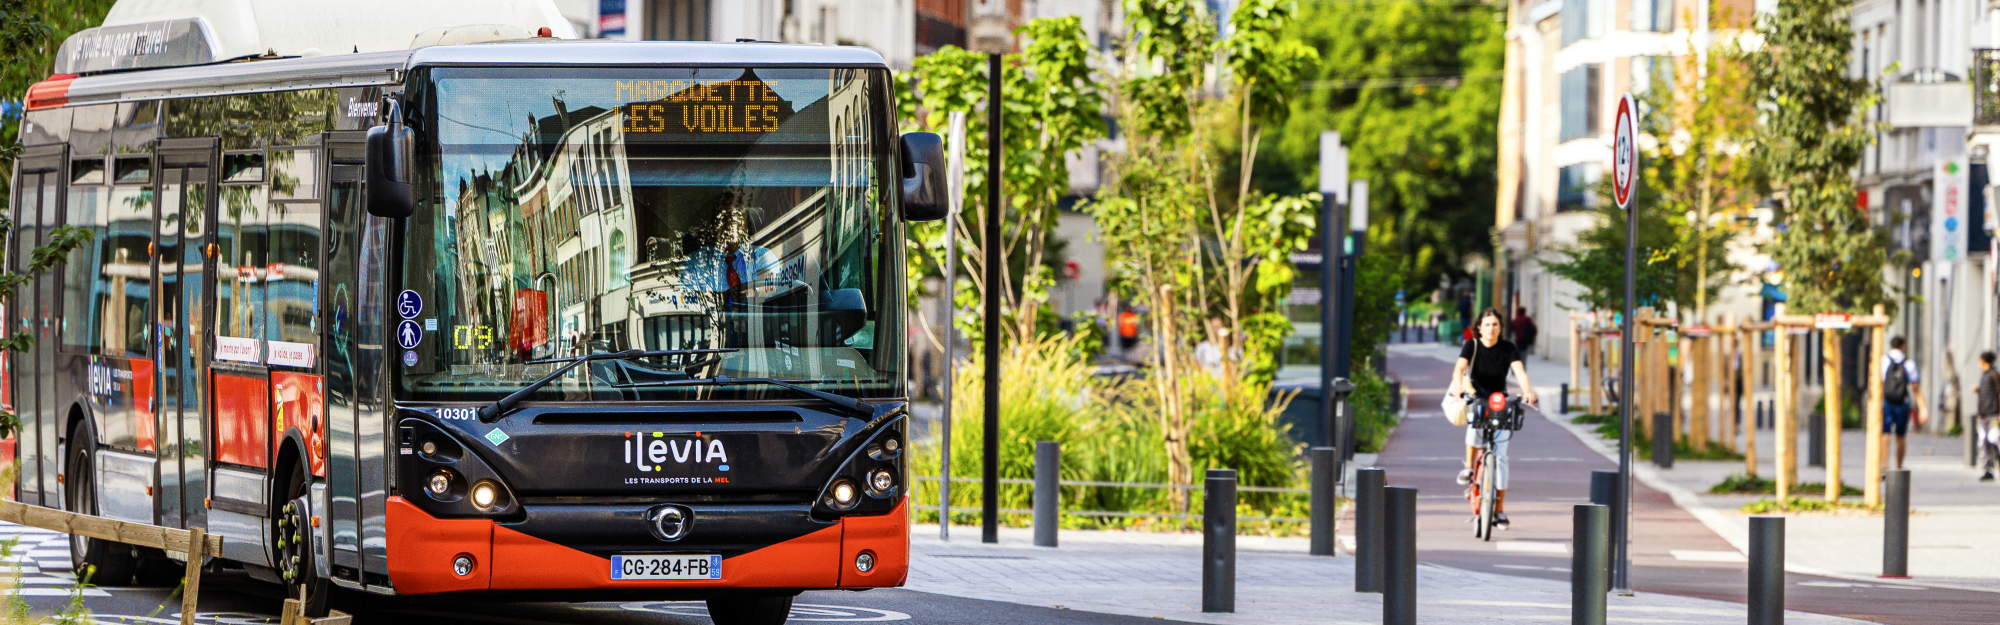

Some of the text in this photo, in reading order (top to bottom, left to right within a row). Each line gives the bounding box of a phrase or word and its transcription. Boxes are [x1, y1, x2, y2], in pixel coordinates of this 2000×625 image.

[81, 28, 102, 60] roule
[101, 33, 114, 58] au
[112, 32, 130, 67] gaz
[616, 80, 778, 101] MARQUETTE
[347, 96, 378, 117] Bienvenue
[614, 105, 779, 132] LES VOILES
[454, 325, 492, 349] 09
[435, 407, 476, 420] 10301
[623, 559, 709, 576] CG-284-FB
[711, 568, 720, 576] 59
